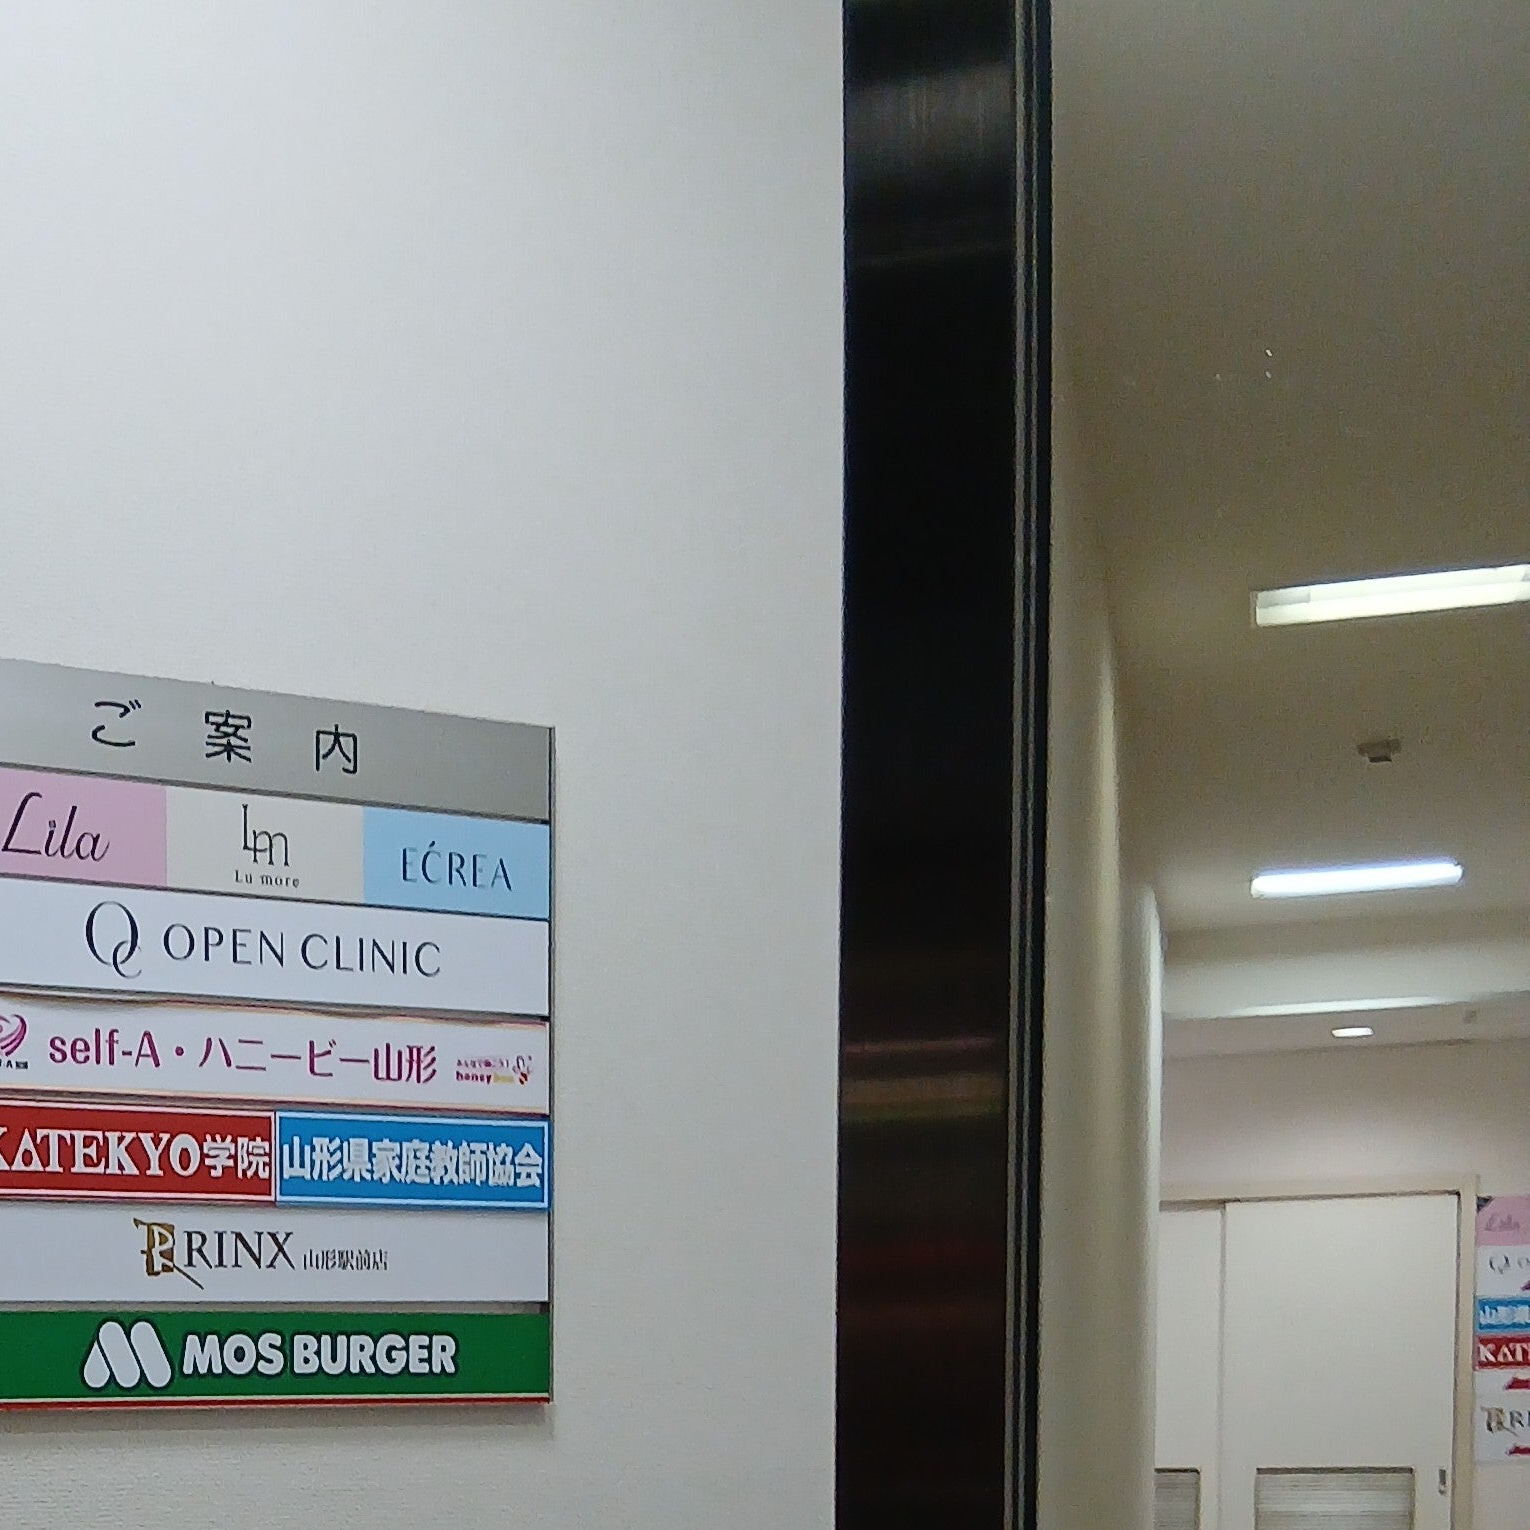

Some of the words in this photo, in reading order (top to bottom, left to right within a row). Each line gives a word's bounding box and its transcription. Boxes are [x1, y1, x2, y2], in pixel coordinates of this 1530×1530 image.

[91, 699, 359, 775] ご案内
[1, 791, 111, 863] Lila
[163, 923, 286, 968] OPEN
[300, 933, 442, 978] CLINIC
[281, 1137, 544, 1189] 山形県家庭教師協会
[183, 1230, 296, 1271] RINX
[183, 1333, 284, 1376] MOS
[293, 1334, 457, 1376] BURGER
